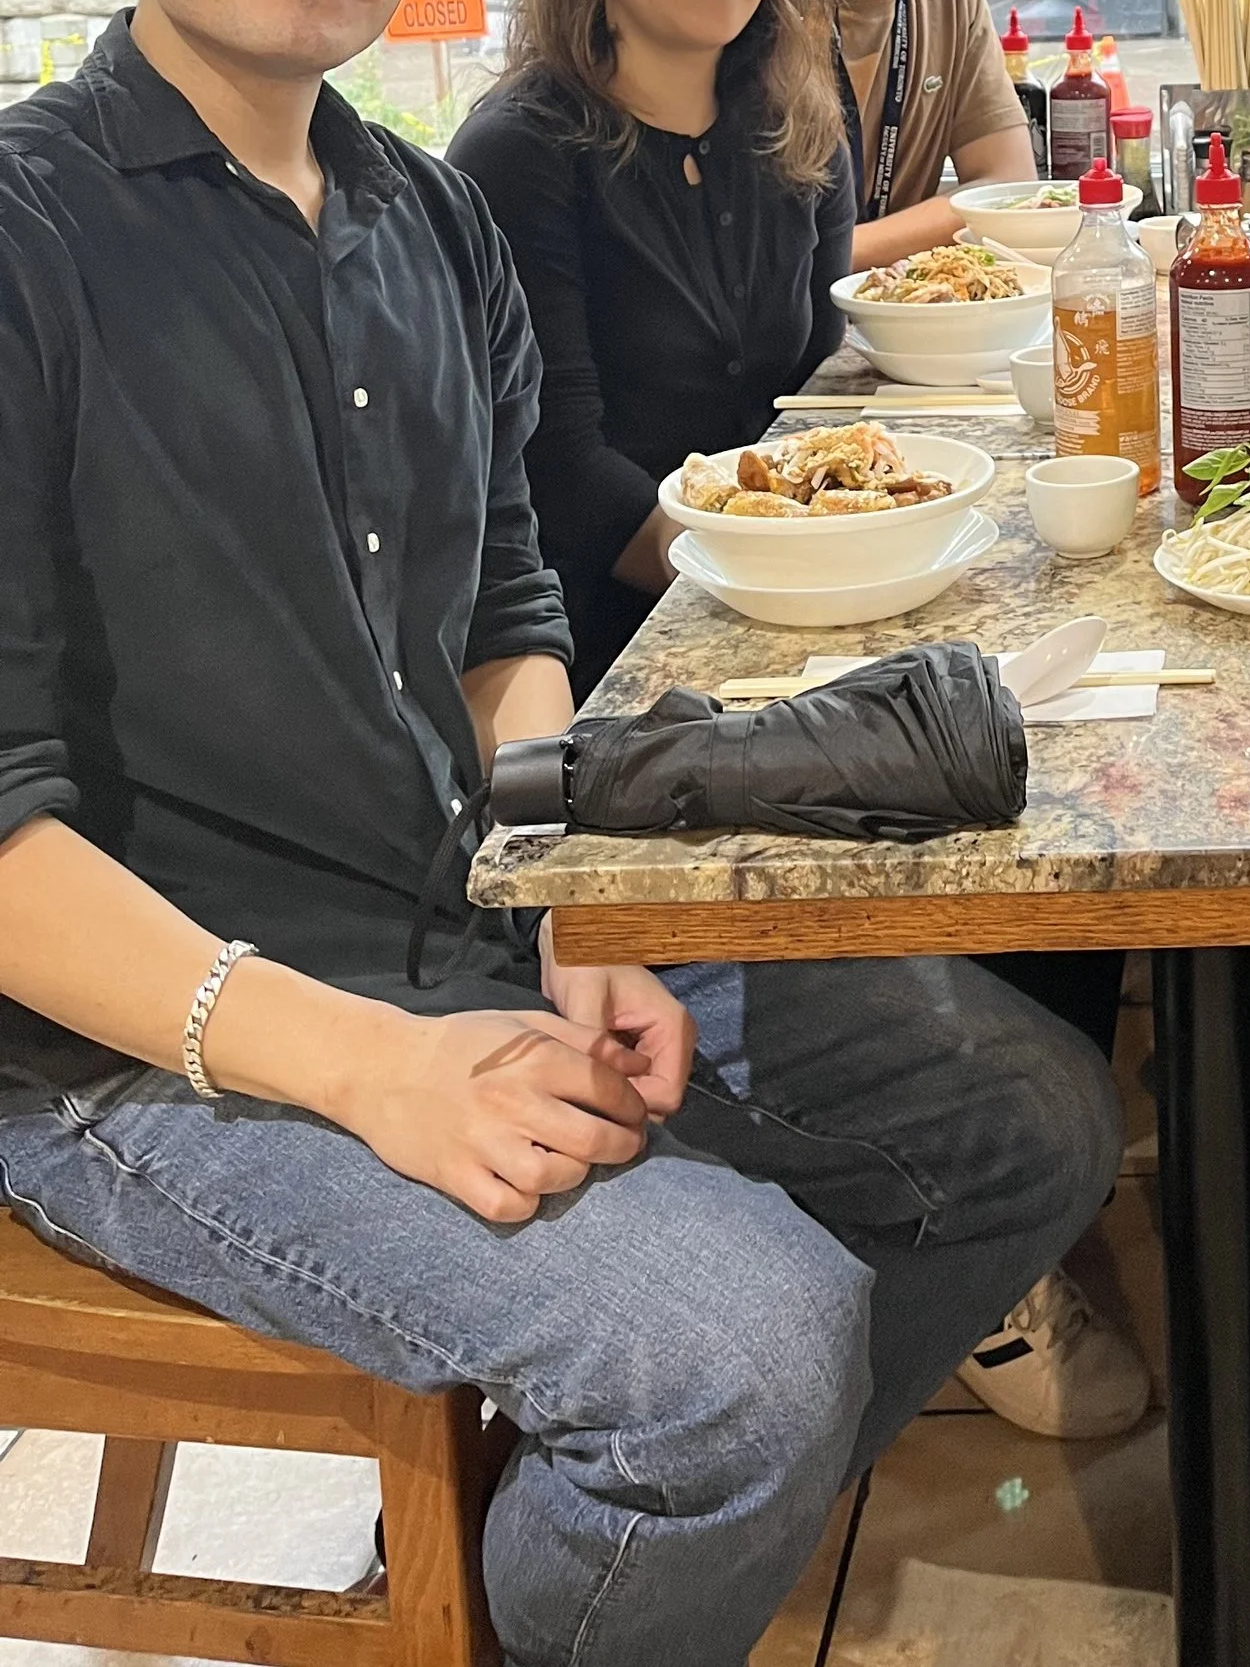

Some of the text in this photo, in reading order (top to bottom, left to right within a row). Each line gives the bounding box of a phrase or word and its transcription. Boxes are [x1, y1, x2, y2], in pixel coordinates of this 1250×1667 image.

[403, 0, 468, 27] CLOSED
[895, 64, 906, 102] TORONTO
[884, 126, 898, 178] UNIVERSITY
[882, 180, 890, 192] OF
[1077, 374, 1101, 403] BRAND
